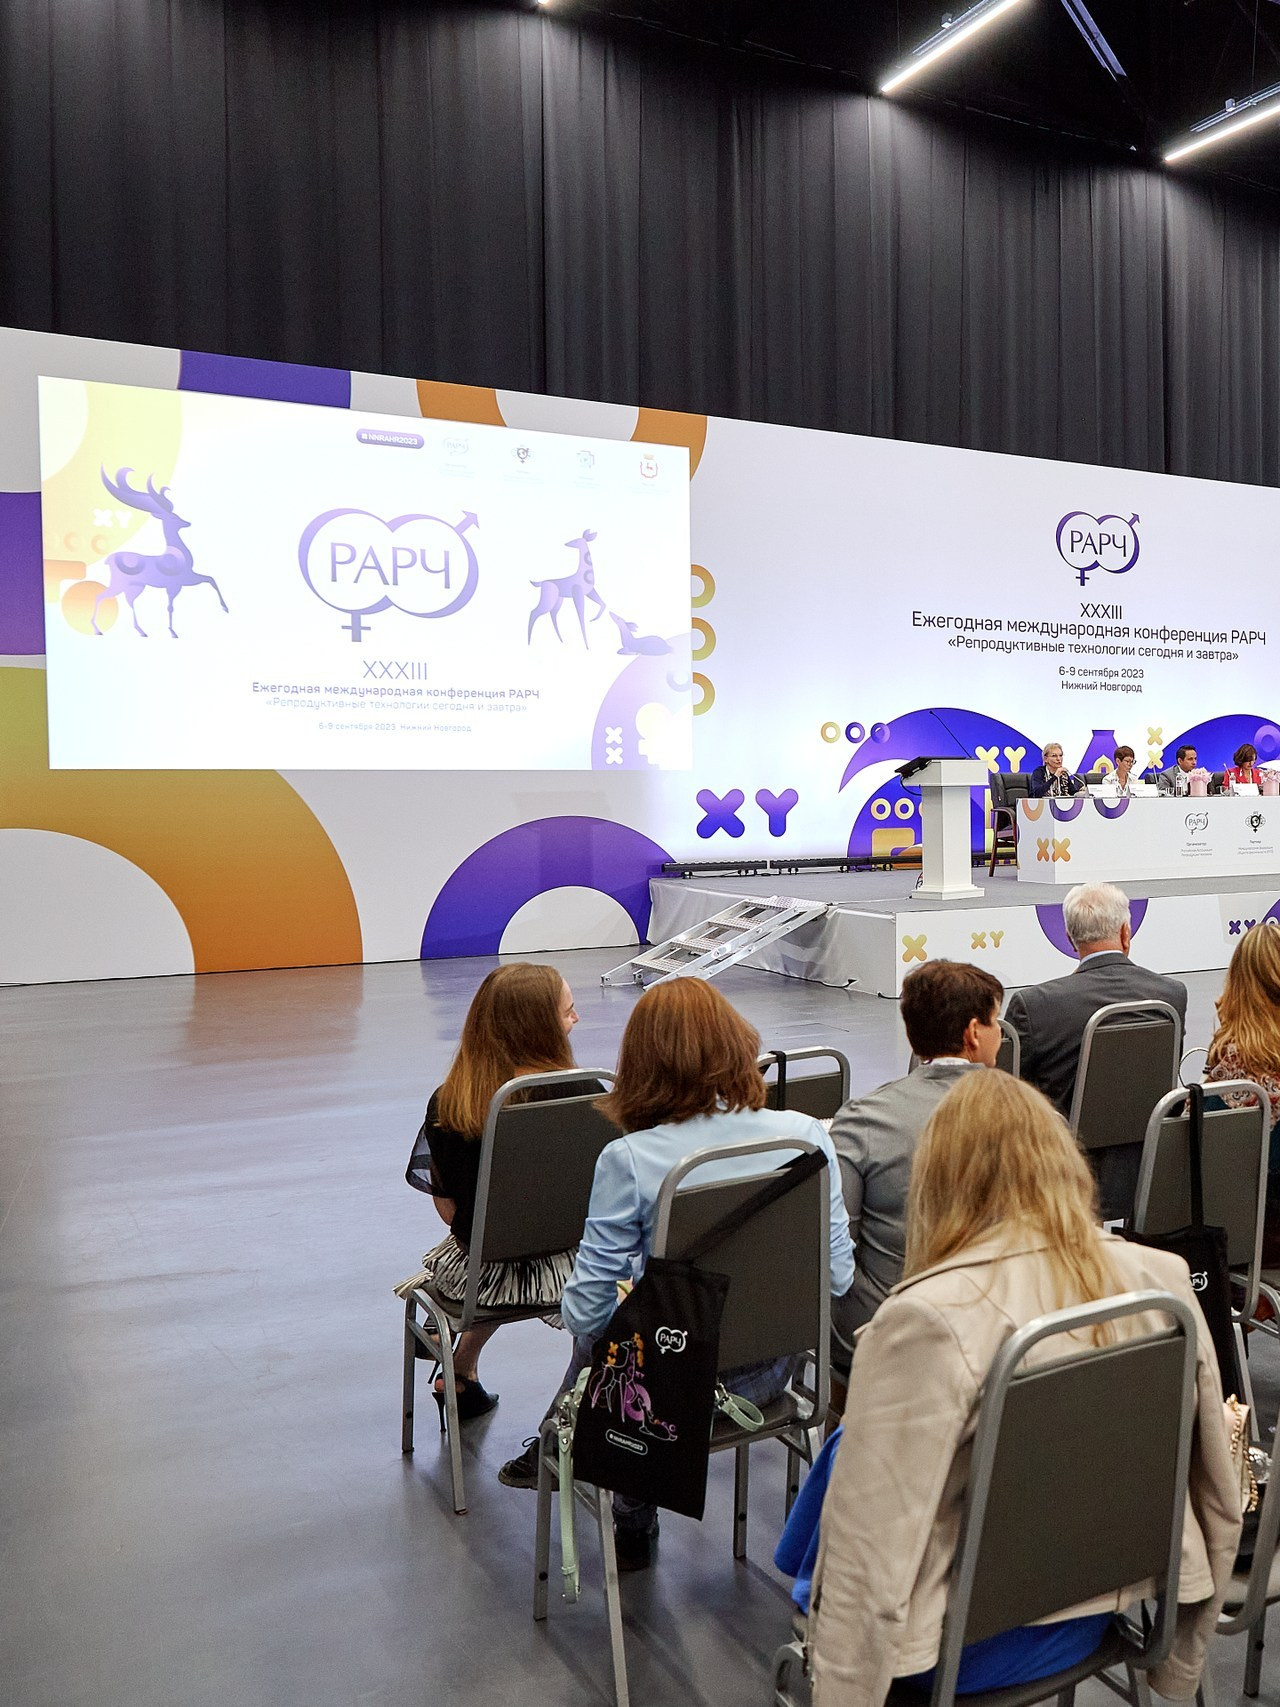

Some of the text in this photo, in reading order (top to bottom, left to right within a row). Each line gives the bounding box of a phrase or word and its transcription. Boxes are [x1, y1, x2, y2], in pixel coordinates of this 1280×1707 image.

[1070, 530, 1126, 557] РАРЧ
[330, 542, 450, 589] РАРЧ
[1080, 602, 1122, 620] XXXIII
[912, 611, 1266, 645] Ежегодная международная конференция РАРЧ
[948, 635, 1239, 663] «Репродуктивные технологии сегодня и завтра»
[362, 660, 428, 680] XXXIII
[1058, 666, 1145, 680] 6-9 сентября 2023
[252, 682, 540, 700] Ежегодная международная конференция РАРЧ
[1061, 680, 1143, 694] Нижний Новгород
[660, 1333, 682, 1347] РАРЧ
